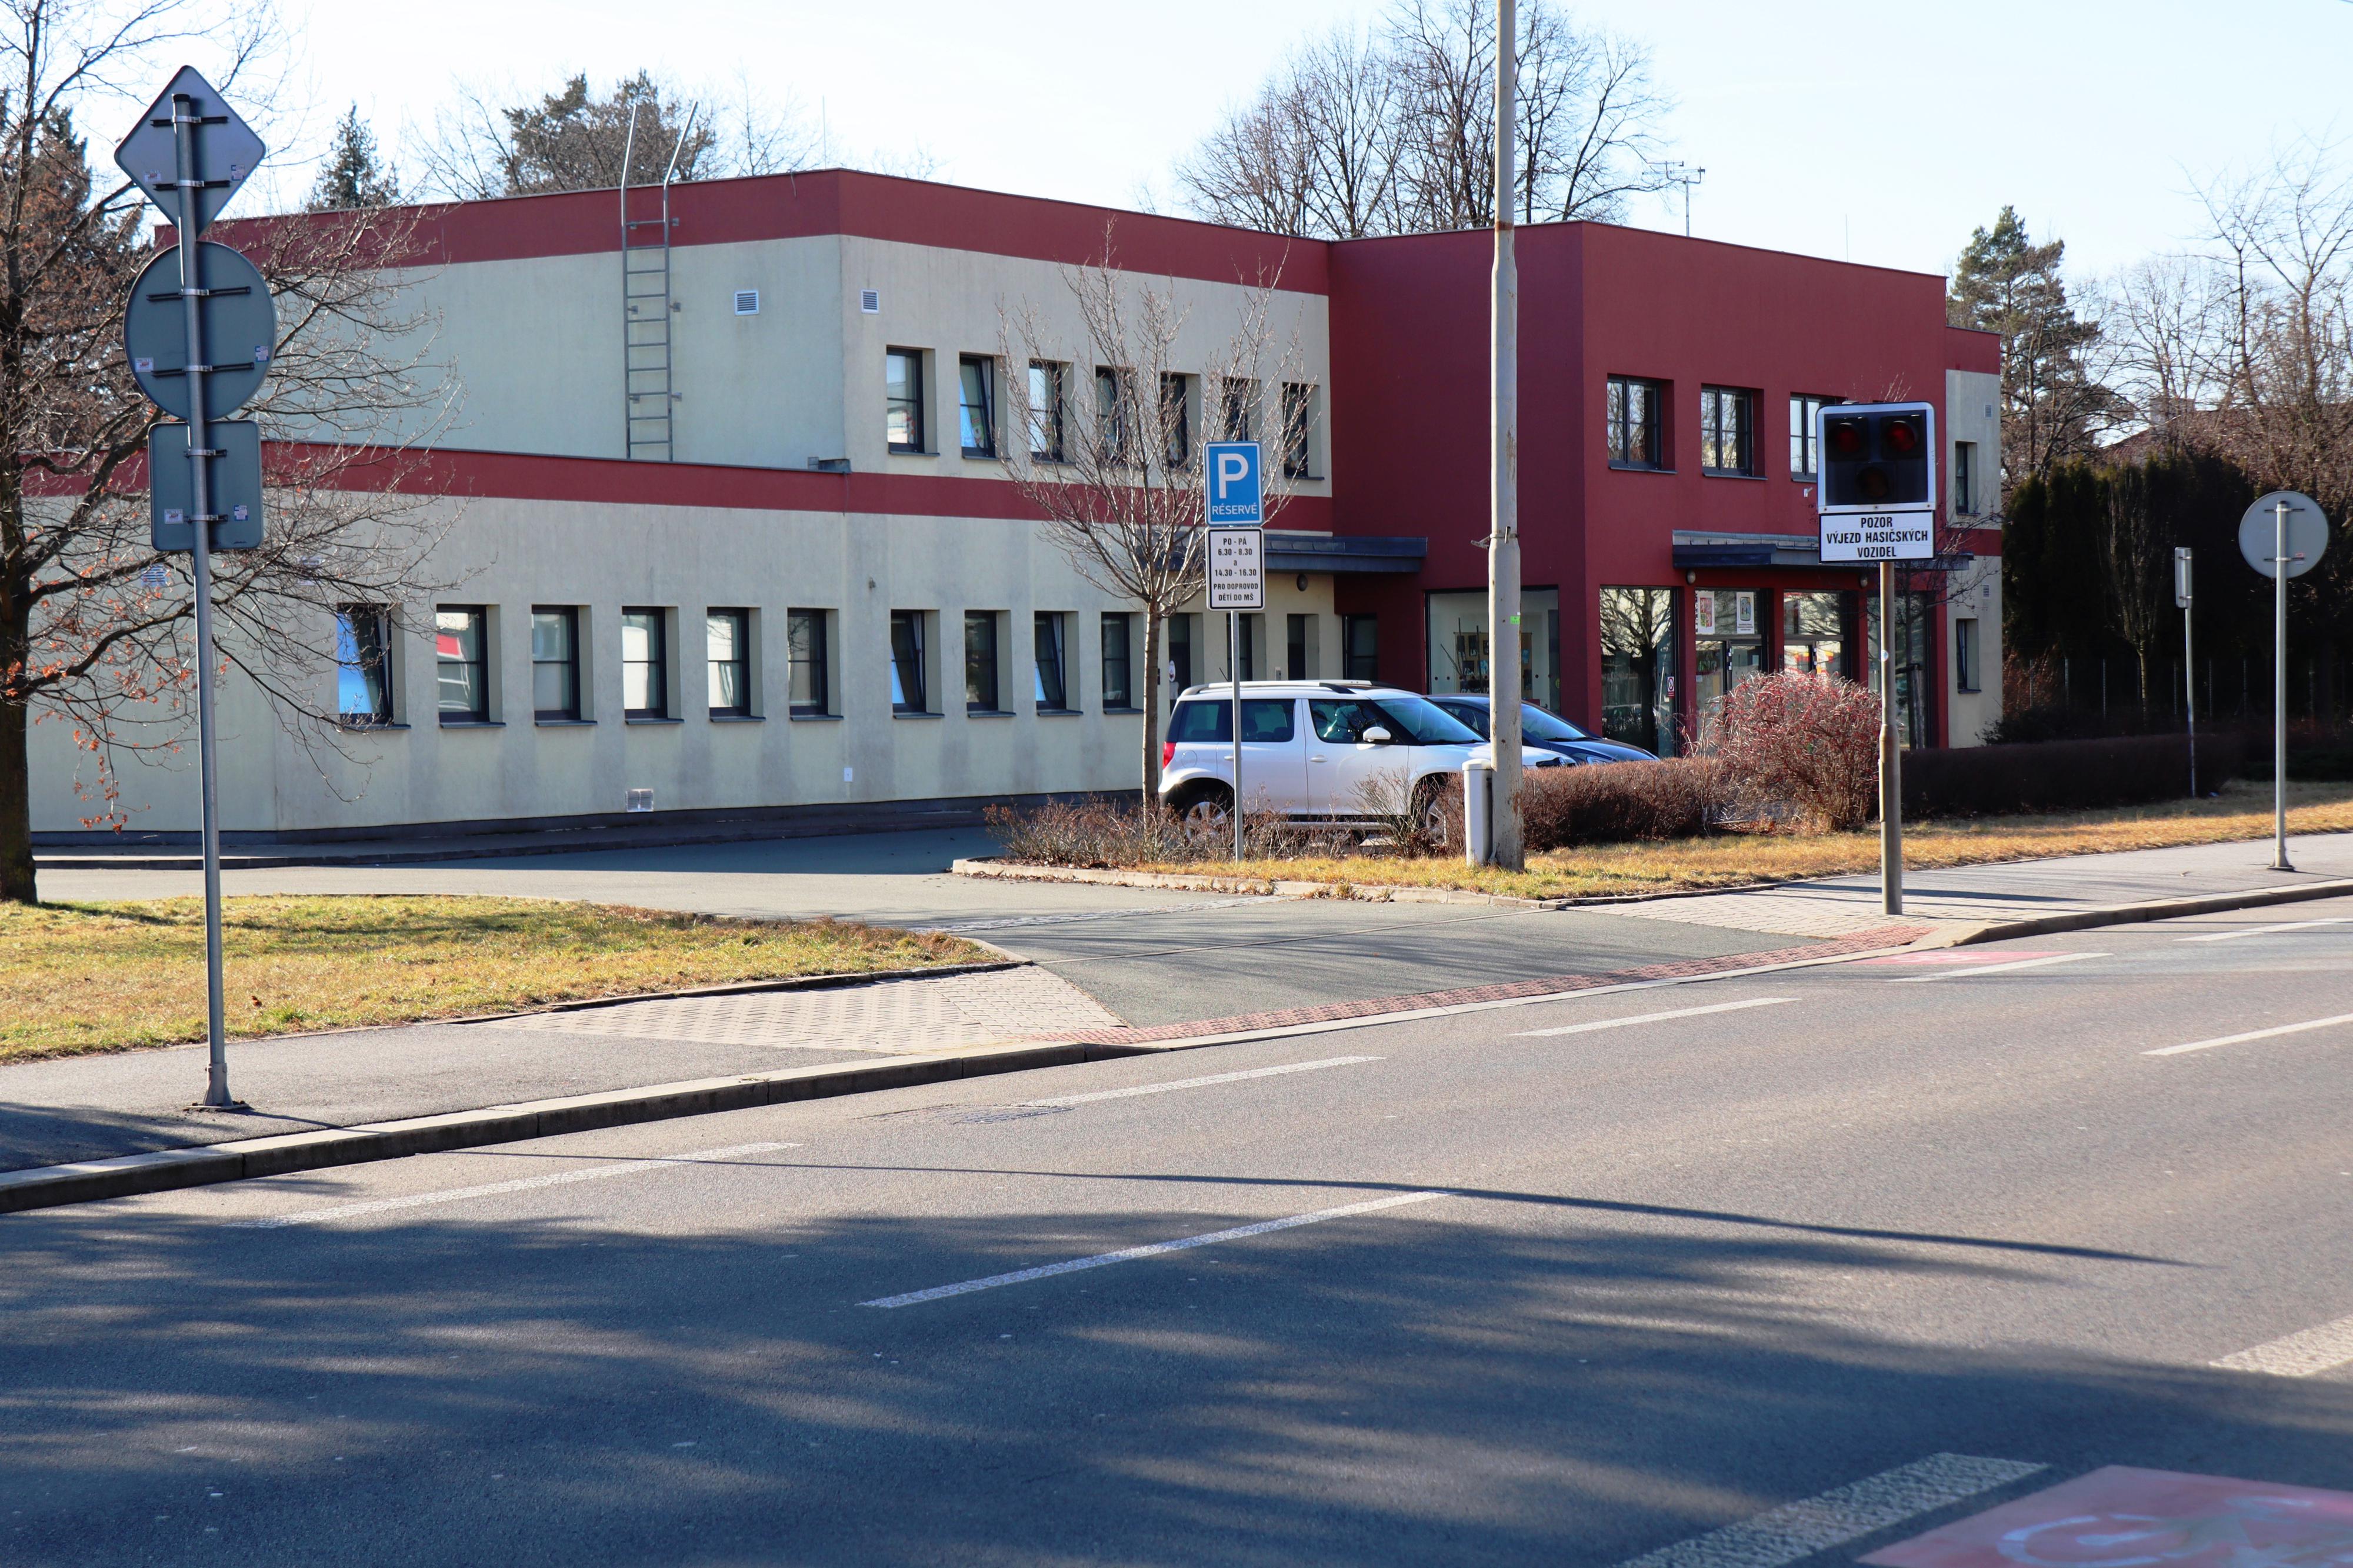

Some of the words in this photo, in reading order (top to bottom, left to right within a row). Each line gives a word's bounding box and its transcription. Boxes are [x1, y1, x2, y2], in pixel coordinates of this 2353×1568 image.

[1218, 453, 1248, 499] P
[1212, 502, 1258, 515] RÉSERVÉ
[1861, 517, 1892, 528] POZOR
[1238, 536, 1247, 545] PÁ
[1827, 531, 1861, 543] VÝJEZD
[1865, 528, 1928, 542] HASIČSKÝCH
[1858, 546, 1897, 558] VOZIDEL
[1218, 592, 1232, 601] DĚTÍ
[1244, 592, 1254, 600] MŠ
